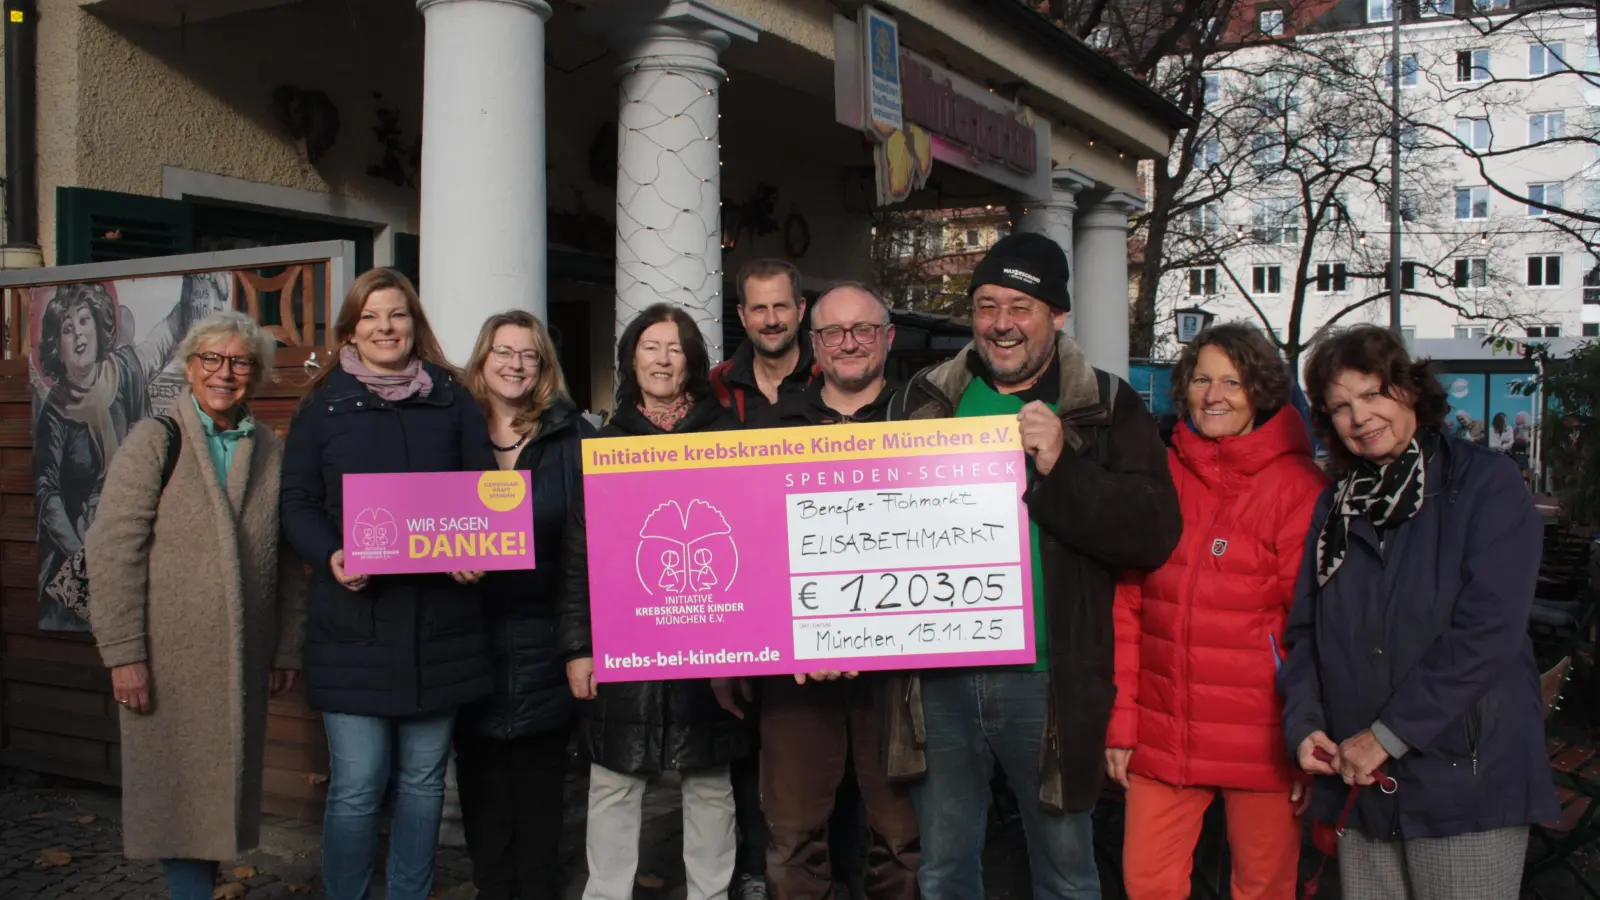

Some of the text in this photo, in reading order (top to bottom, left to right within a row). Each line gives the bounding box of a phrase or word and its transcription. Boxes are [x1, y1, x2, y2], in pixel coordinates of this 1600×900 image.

[593, 426, 1014, 466] Initiative krebskranke Kinder München e.V.
[785, 461, 1016, 487] SPENDEN-SCHECK
[406, 516, 489, 532] WIR SAGEN
[408, 531, 527, 559] DANKE!
[801, 523, 1004, 556] ELISABETHMARKT
[665, 594, 713, 605] INITIATIVE
[797, 572, 1006, 612] € 1.203,05
[635, 603, 745, 616] KREBSKRANKE KINDER
[655, 613, 725, 626] MÜNCHEN E.V.
[908, 619, 1004, 642] 15.11.25
[604, 646, 780, 669] krebs-bei-kindern.de
